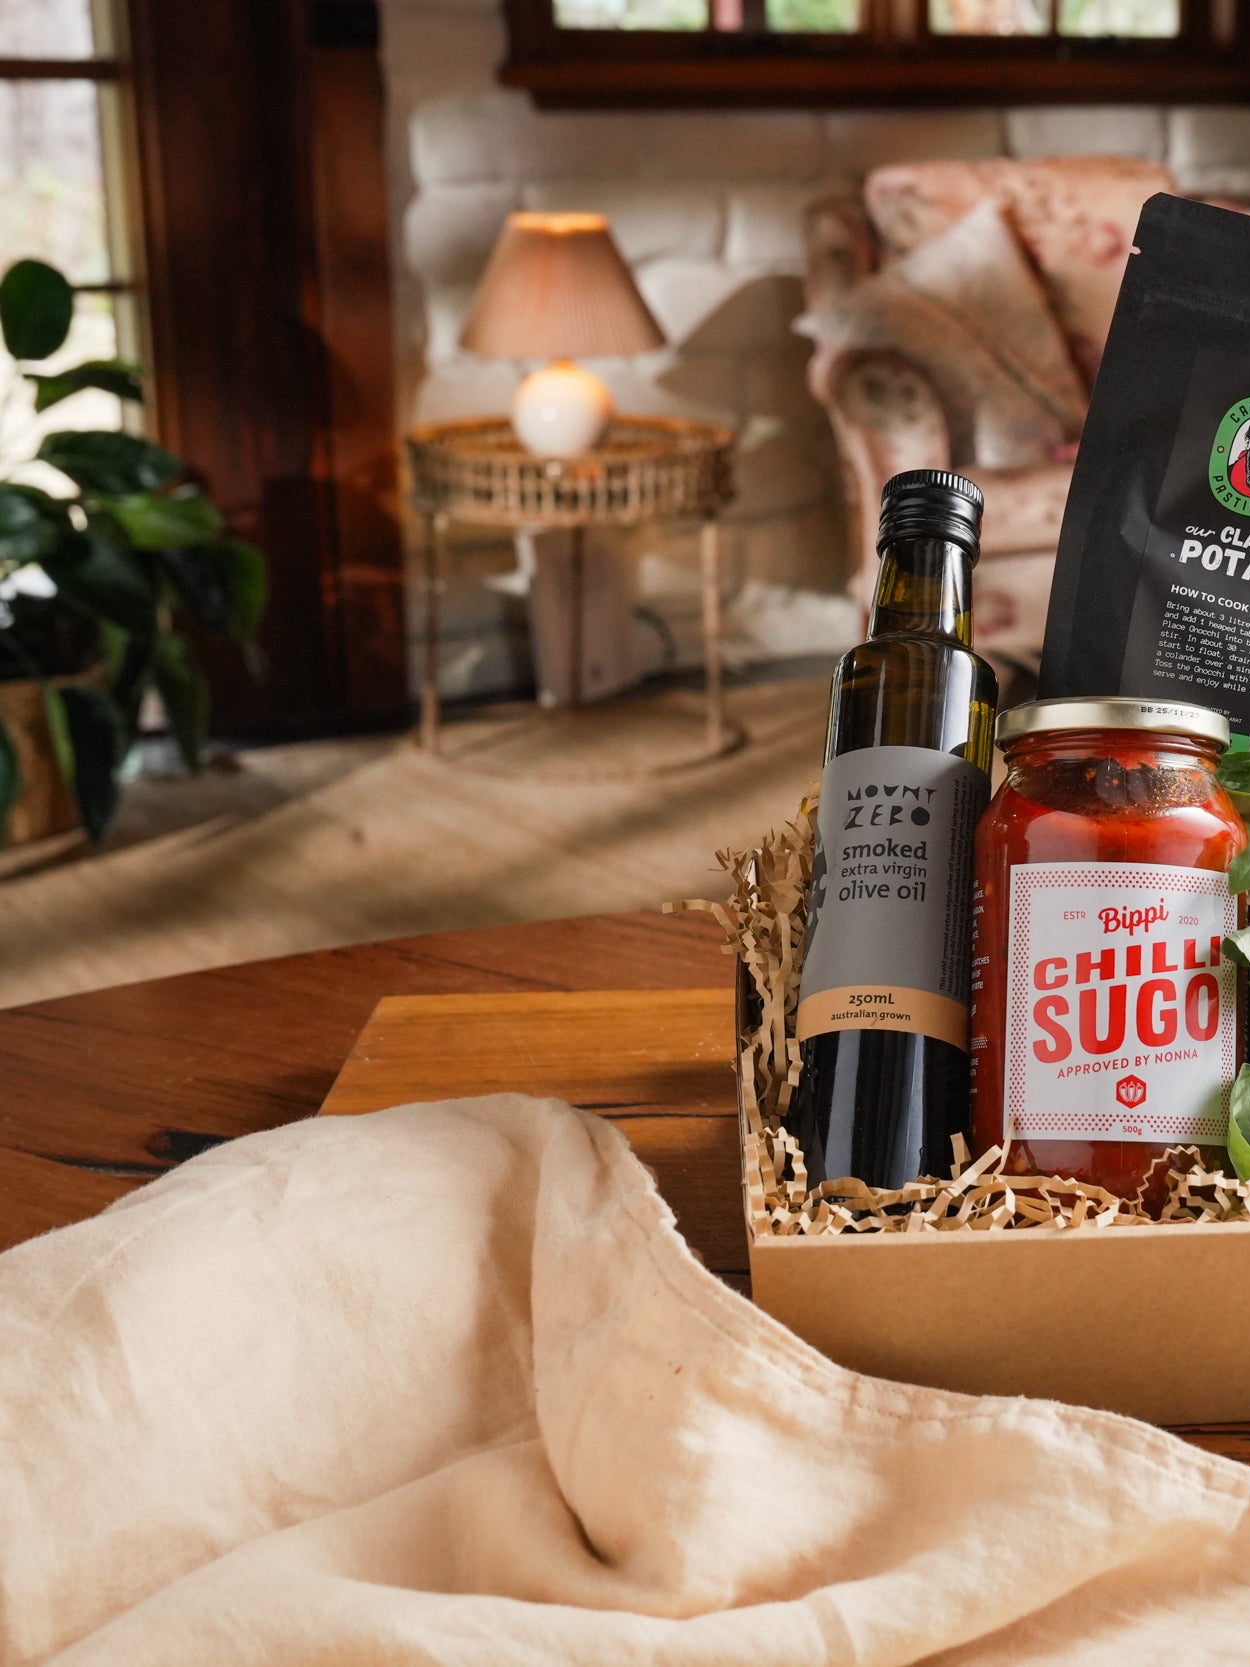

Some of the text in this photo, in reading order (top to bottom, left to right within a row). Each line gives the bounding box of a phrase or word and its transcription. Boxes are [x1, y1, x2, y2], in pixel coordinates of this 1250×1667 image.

[1185, 525, 1216, 538] our
[1171, 584, 1199, 598] HOW
[1201, 592, 1215, 603] TO
[1218, 597, 1249, 613] COOK
[1166, 601, 1190, 614] Bring
[1193, 608, 1216, 619] about
[1162, 619, 1186, 631] Place
[1189, 625, 1220, 639] Gnocchi
[1225, 633, 1243, 644] into
[1164, 611, 1179, 620] and
[1182, 615, 1197, 623] add
[1208, 620, 1237, 633] heaped
[1158, 640, 1181, 650] start
[1185, 644, 1195, 652] to
[1198, 647, 1224, 660] float,
[1160, 630, 1182, 640] stir.
[1187, 634, 1197, 643] In
[1200, 638, 1223, 649] about
[1155, 658, 1173, 668] Toss
[1177, 662, 1191, 671] the
[1193, 665, 1225, 678] Gnocchi
[1229, 674, 1248, 683] with
[1165, 651, 1202, 663] colander
[1204, 659, 1224, 668] over
[1153, 669, 1176, 679] serve
[1178, 674, 1194, 682] and
[1196, 677, 1220, 688] enjoy
[1223, 682, 1246, 692] while
[847, 785, 938, 804] MOUNT
[844, 804, 931, 831] ZERO
[842, 838, 928, 861] smoked
[841, 861, 927, 880] extra virgin
[838, 880, 926, 902] olive oil
[1097, 897, 1169, 937] Bippi
[1178, 915, 1199, 926] 2020
[1033, 935, 1221, 991] CHILLI
[848, 992, 895, 1007] 250mL
[830, 1009, 912, 1021] australian grown
[1032, 972, 1220, 1064] SUGO
[1057, 1048, 1199, 1079] APPROVED BY NONNA
[1122, 1125, 1142, 1136] 500g
